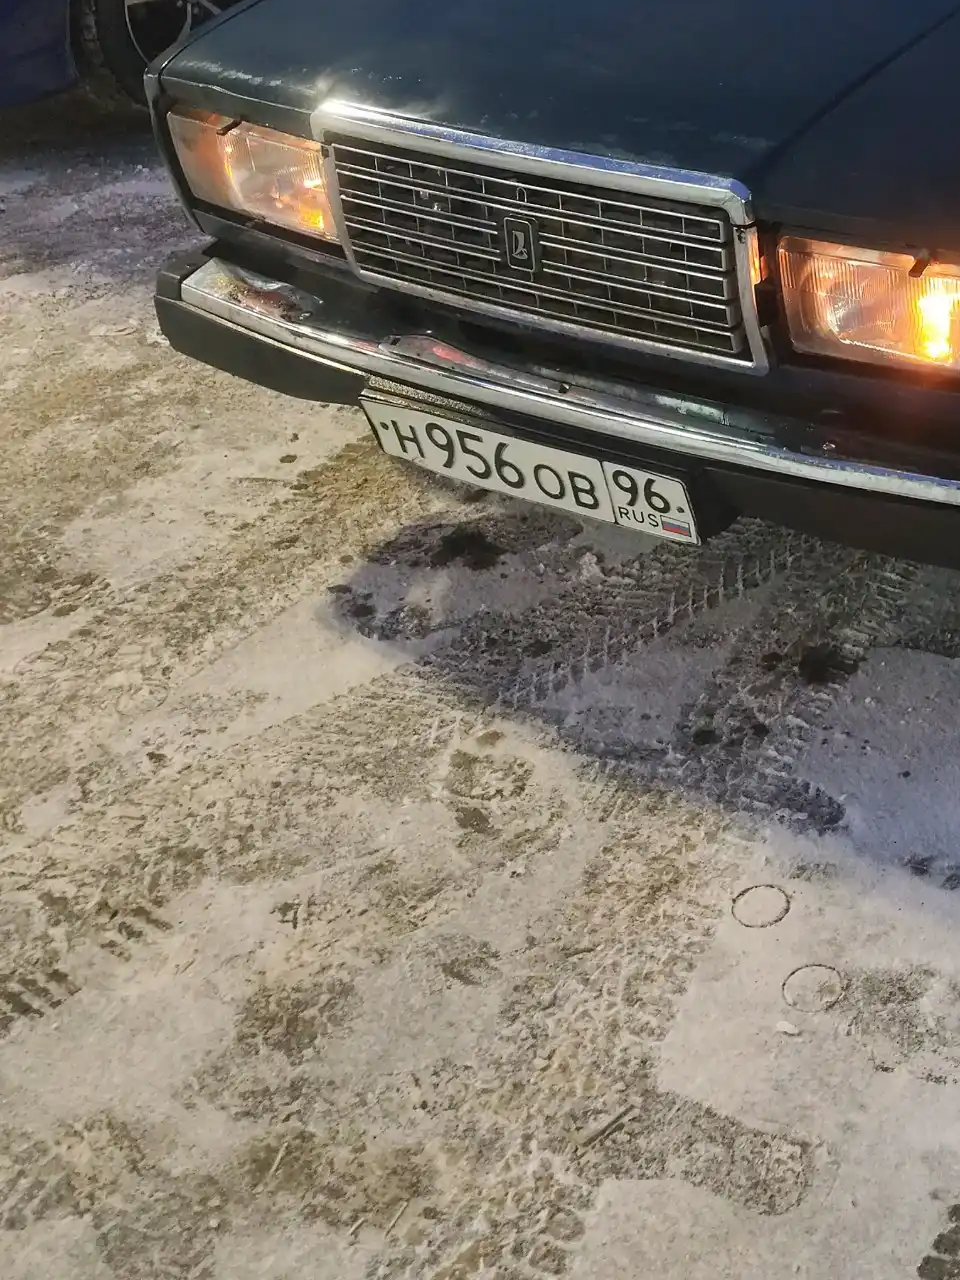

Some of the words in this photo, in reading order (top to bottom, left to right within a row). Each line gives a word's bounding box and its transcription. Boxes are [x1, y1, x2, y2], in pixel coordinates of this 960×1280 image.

[389, 418, 601, 512] Н956ОВ
[611, 468, 671, 515] 96
[617, 505, 661, 529] RUS
